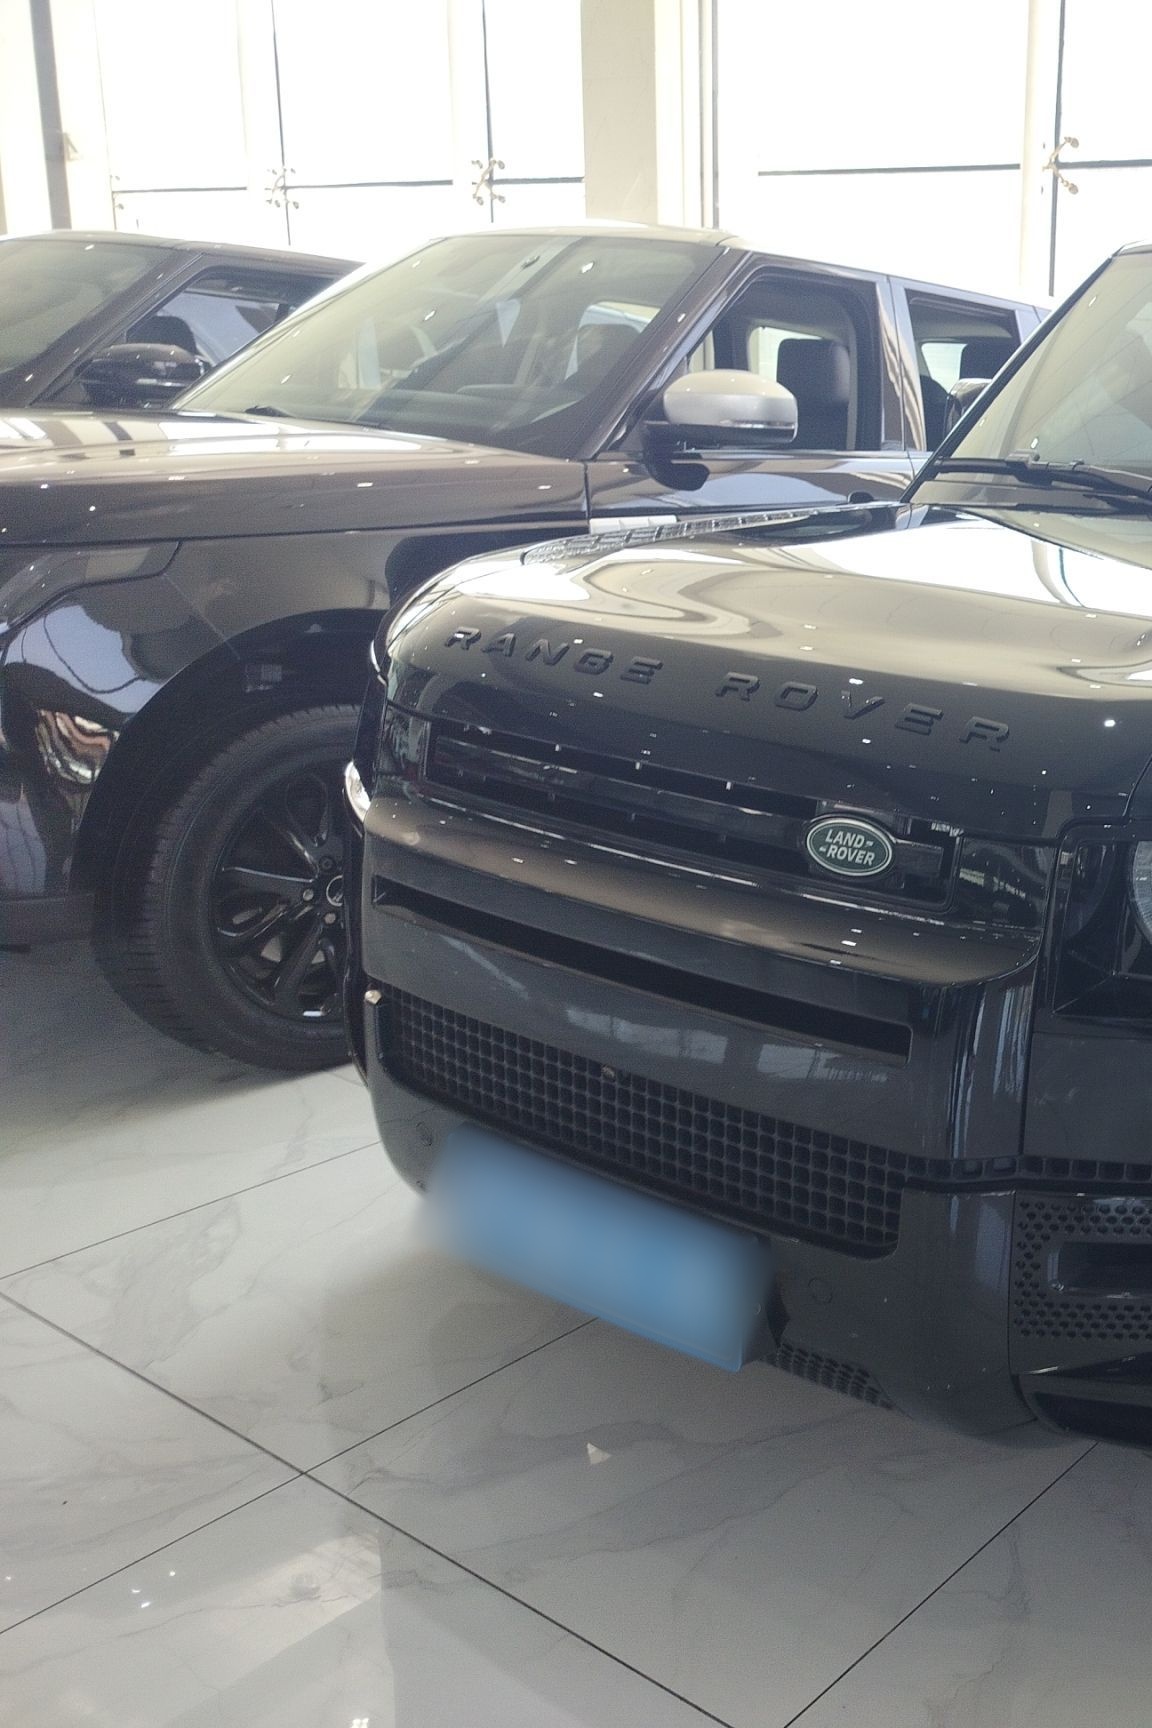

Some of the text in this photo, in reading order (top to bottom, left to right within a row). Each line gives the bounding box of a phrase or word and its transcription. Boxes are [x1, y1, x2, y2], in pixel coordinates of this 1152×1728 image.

[444, 626, 1010, 752] RANGE ROVER
[825, 829, 865, 848] LAND
[827, 845, 875, 866] ROVER
